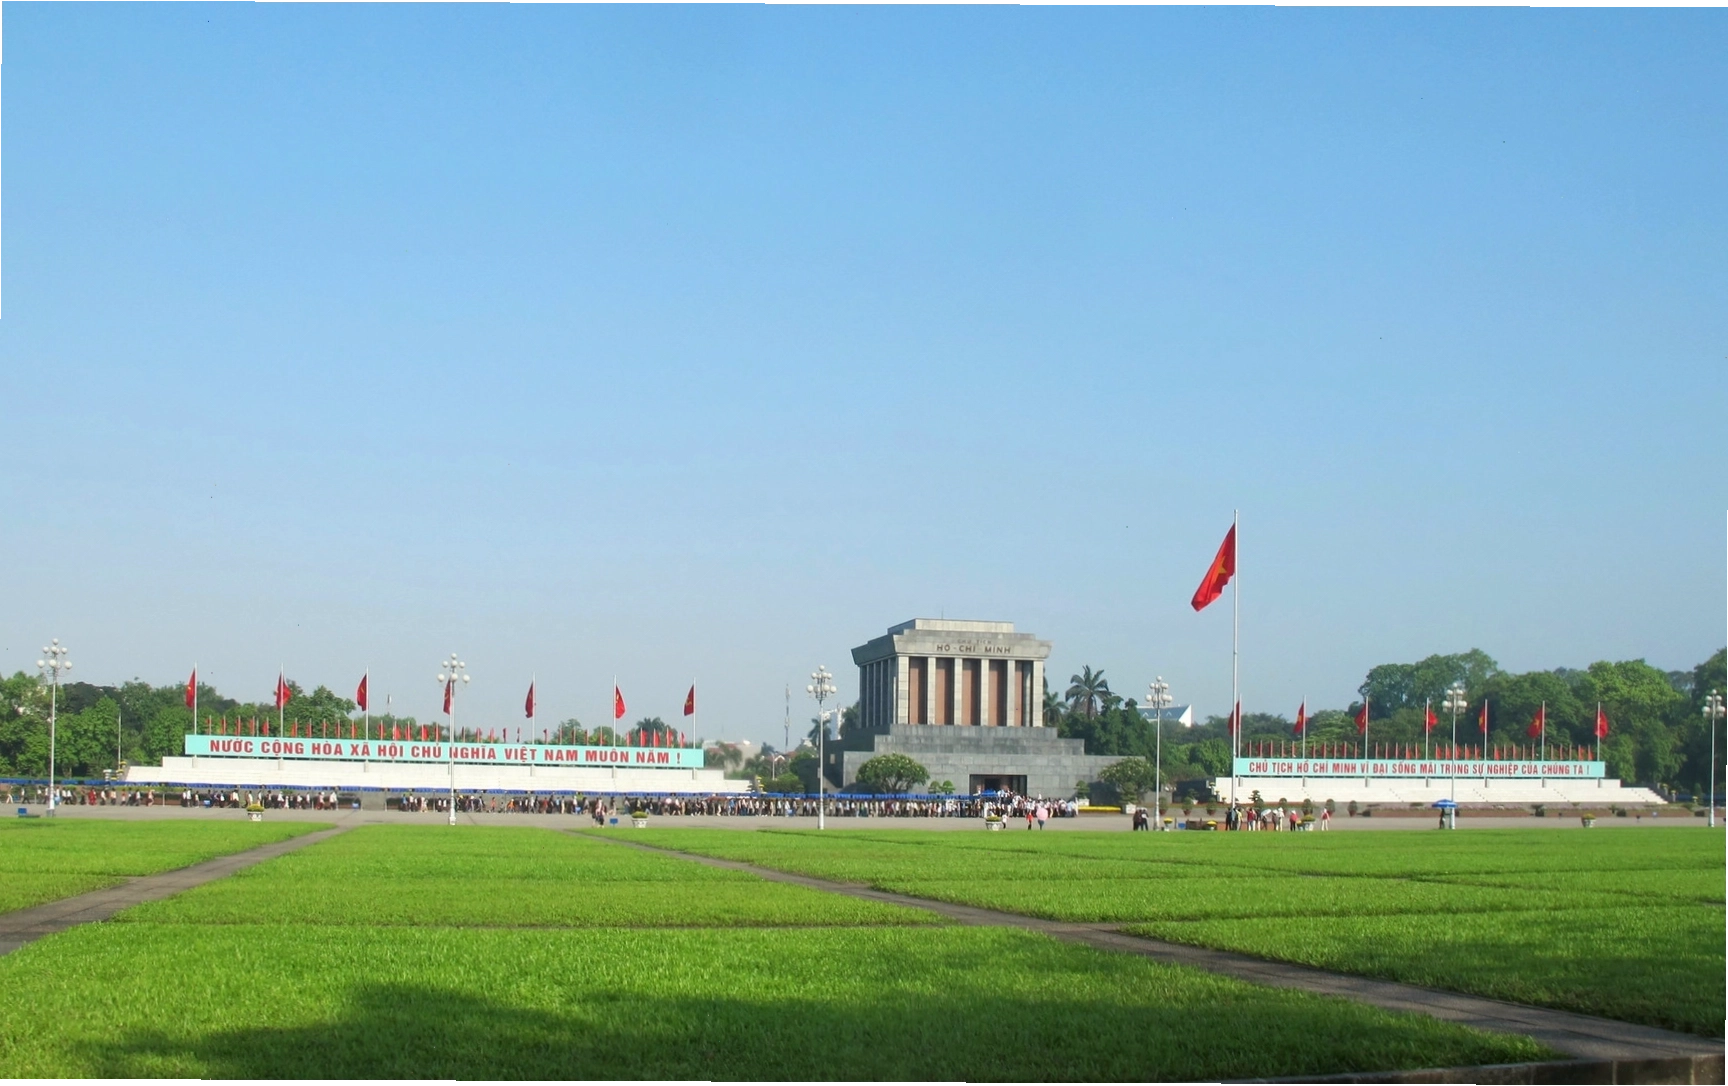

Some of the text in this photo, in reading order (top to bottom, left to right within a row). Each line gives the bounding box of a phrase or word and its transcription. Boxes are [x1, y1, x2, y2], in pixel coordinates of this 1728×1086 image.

[210, 738, 253, 753] NƯỚC
[261, 739, 304, 756] CỘNG
[312, 741, 343, 755] HÒA
[351, 742, 370, 756] XÃ
[378, 742, 403, 759] HỘI
[411, 743, 442, 758] CHỦ
[449, 745, 496, 760] NGHĨA
[504, 746, 537, 762] VIỆT
[544, 750, 578, 762] NAM
[585, 748, 630, 763] MUÔN
[636, 750, 669, 763] NĂM
[1249, 760, 1268, 773] CHỦ
[1272, 762, 1293, 775] TỊCH
[1313, 761, 1328, 773] CHÍ
[1333, 763, 1356, 773] MINH
[1373, 763, 1388, 776] ĐẠI
[1392, 760, 1416, 774] SỐNG
[1473, 763, 1484, 776] SỰ
[1487, 763, 1518, 777] NGHIỆP
[1522, 762, 1538, 774] CỦA
[1542, 763, 1570, 774] CHÚNG
[1573, 765, 1583, 774] TA
